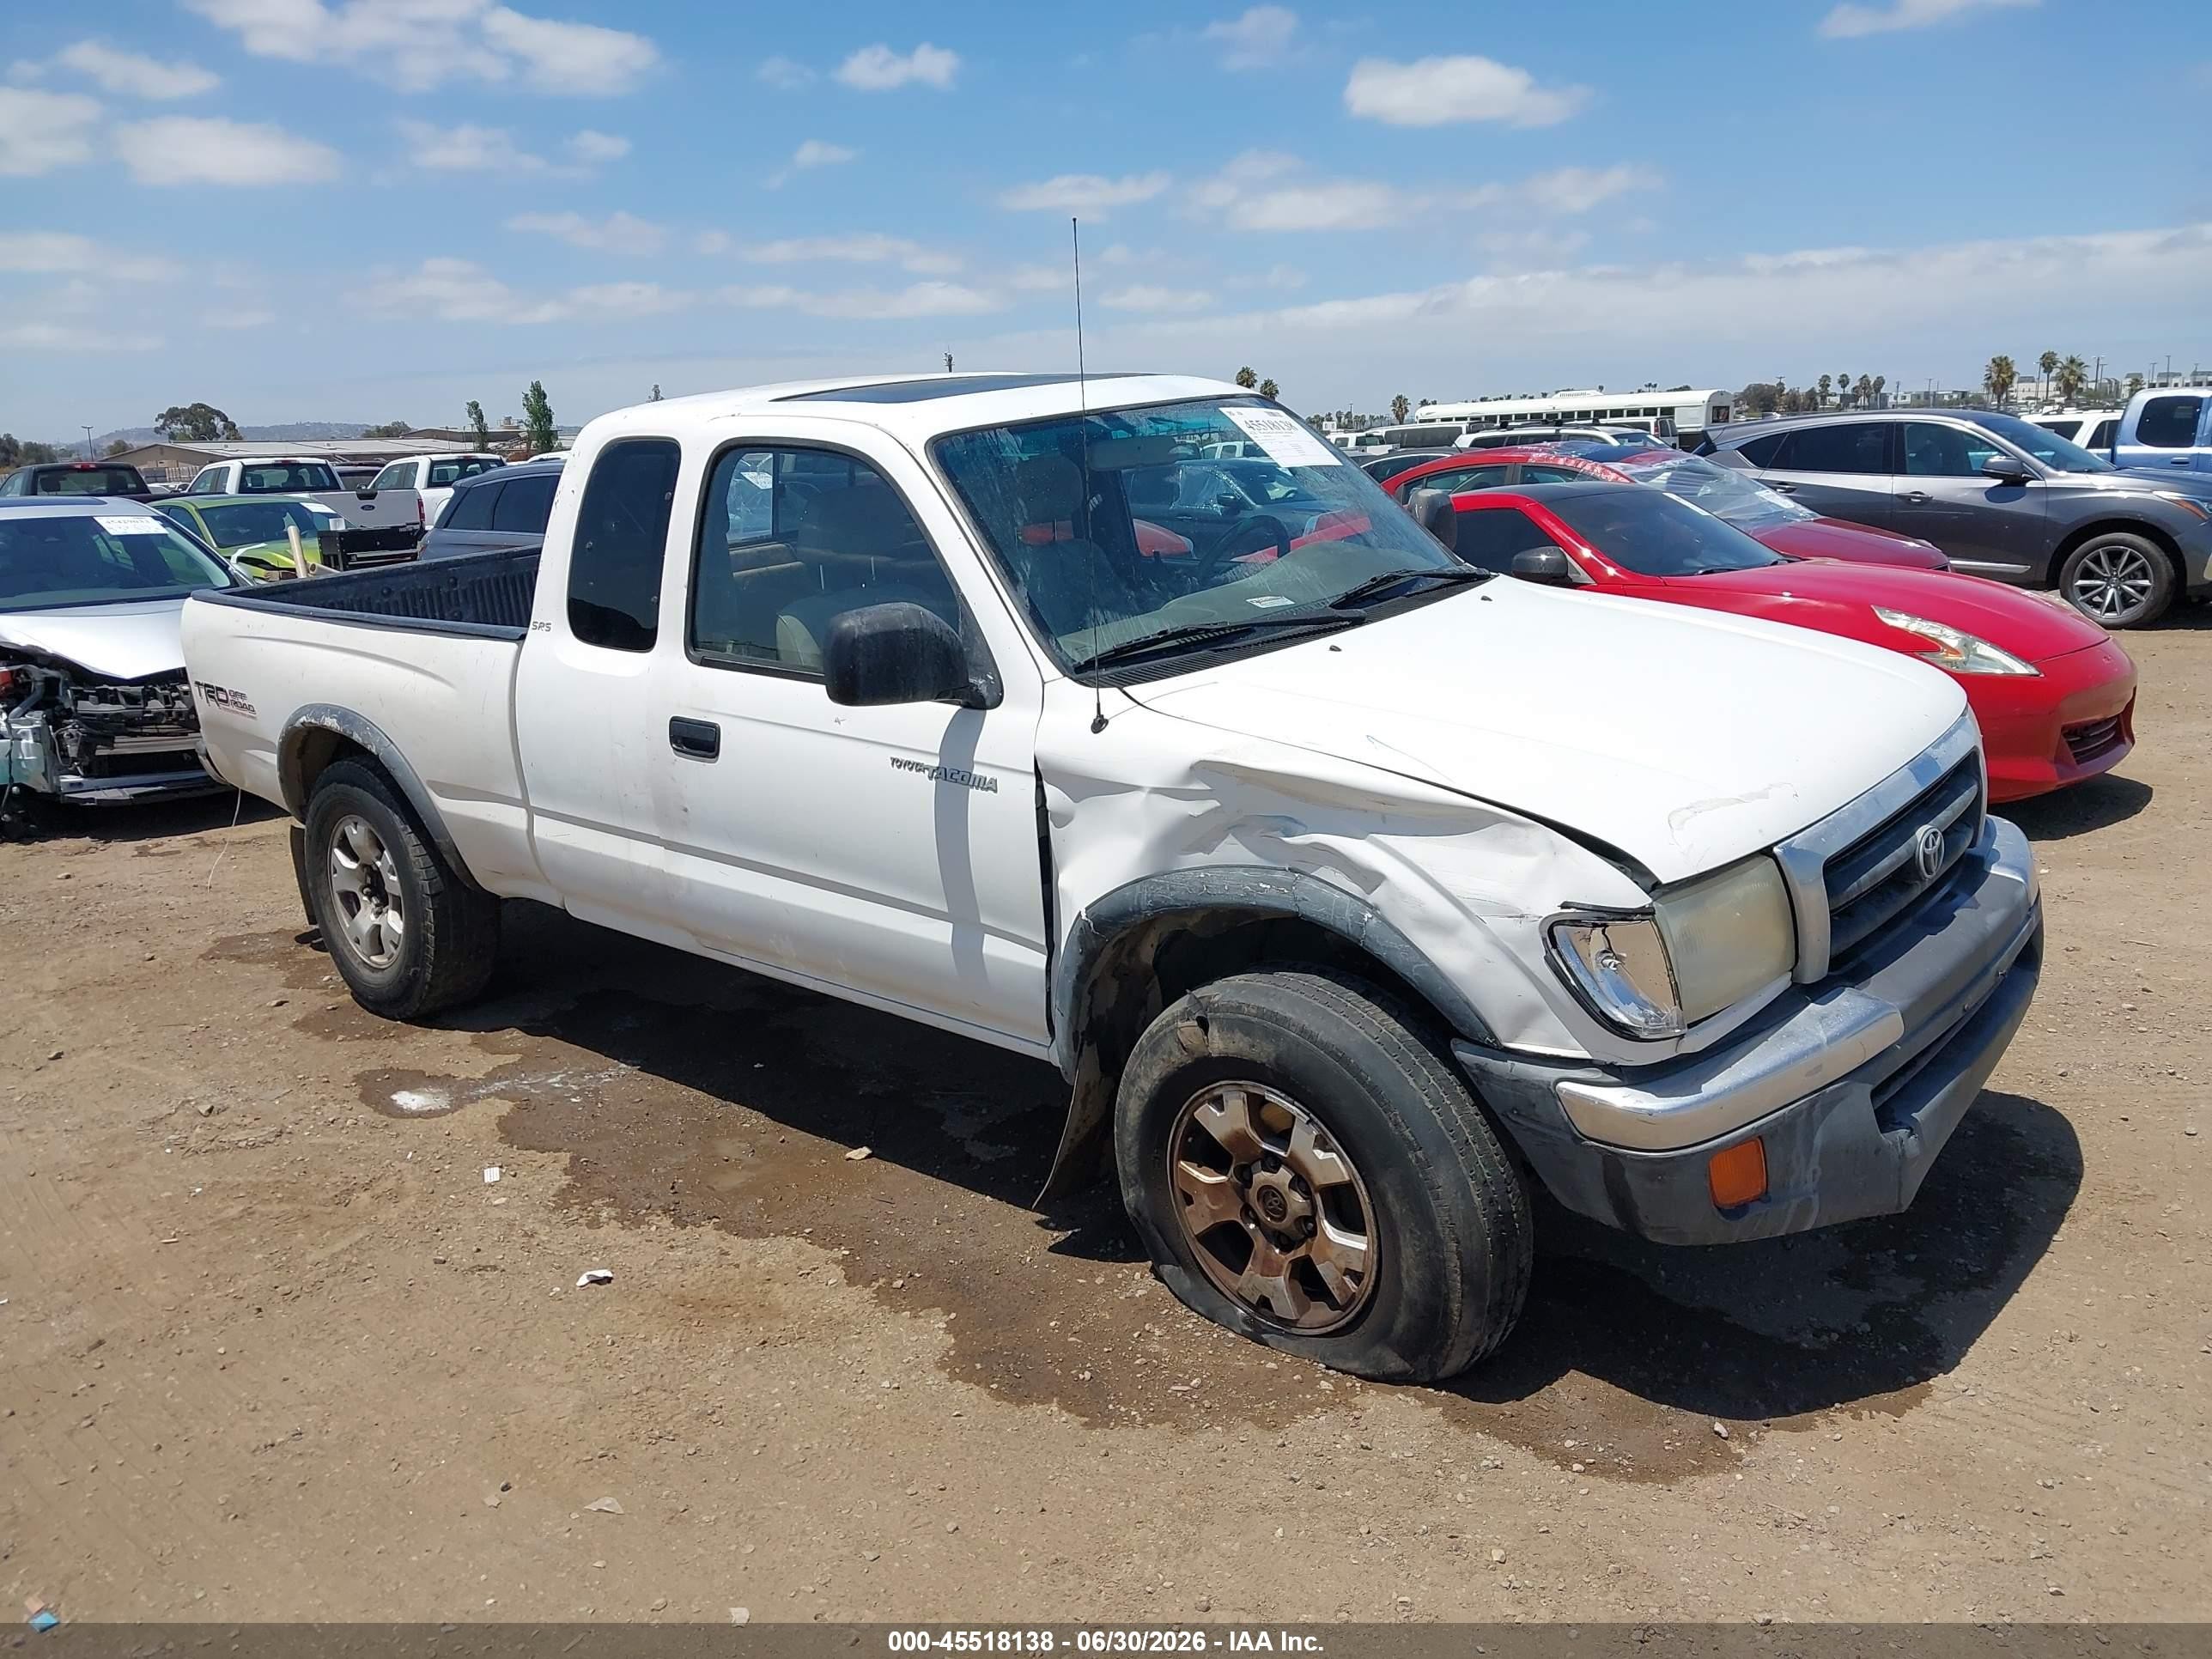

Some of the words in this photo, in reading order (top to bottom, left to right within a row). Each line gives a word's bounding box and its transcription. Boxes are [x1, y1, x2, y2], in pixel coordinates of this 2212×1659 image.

[194, 681, 229, 709] TRD
[228, 690, 247, 700] OFF
[230, 700, 257, 714] ROAD
[890, 757, 927, 774] TOYOTA
[925, 765, 999, 793] TACOMA
